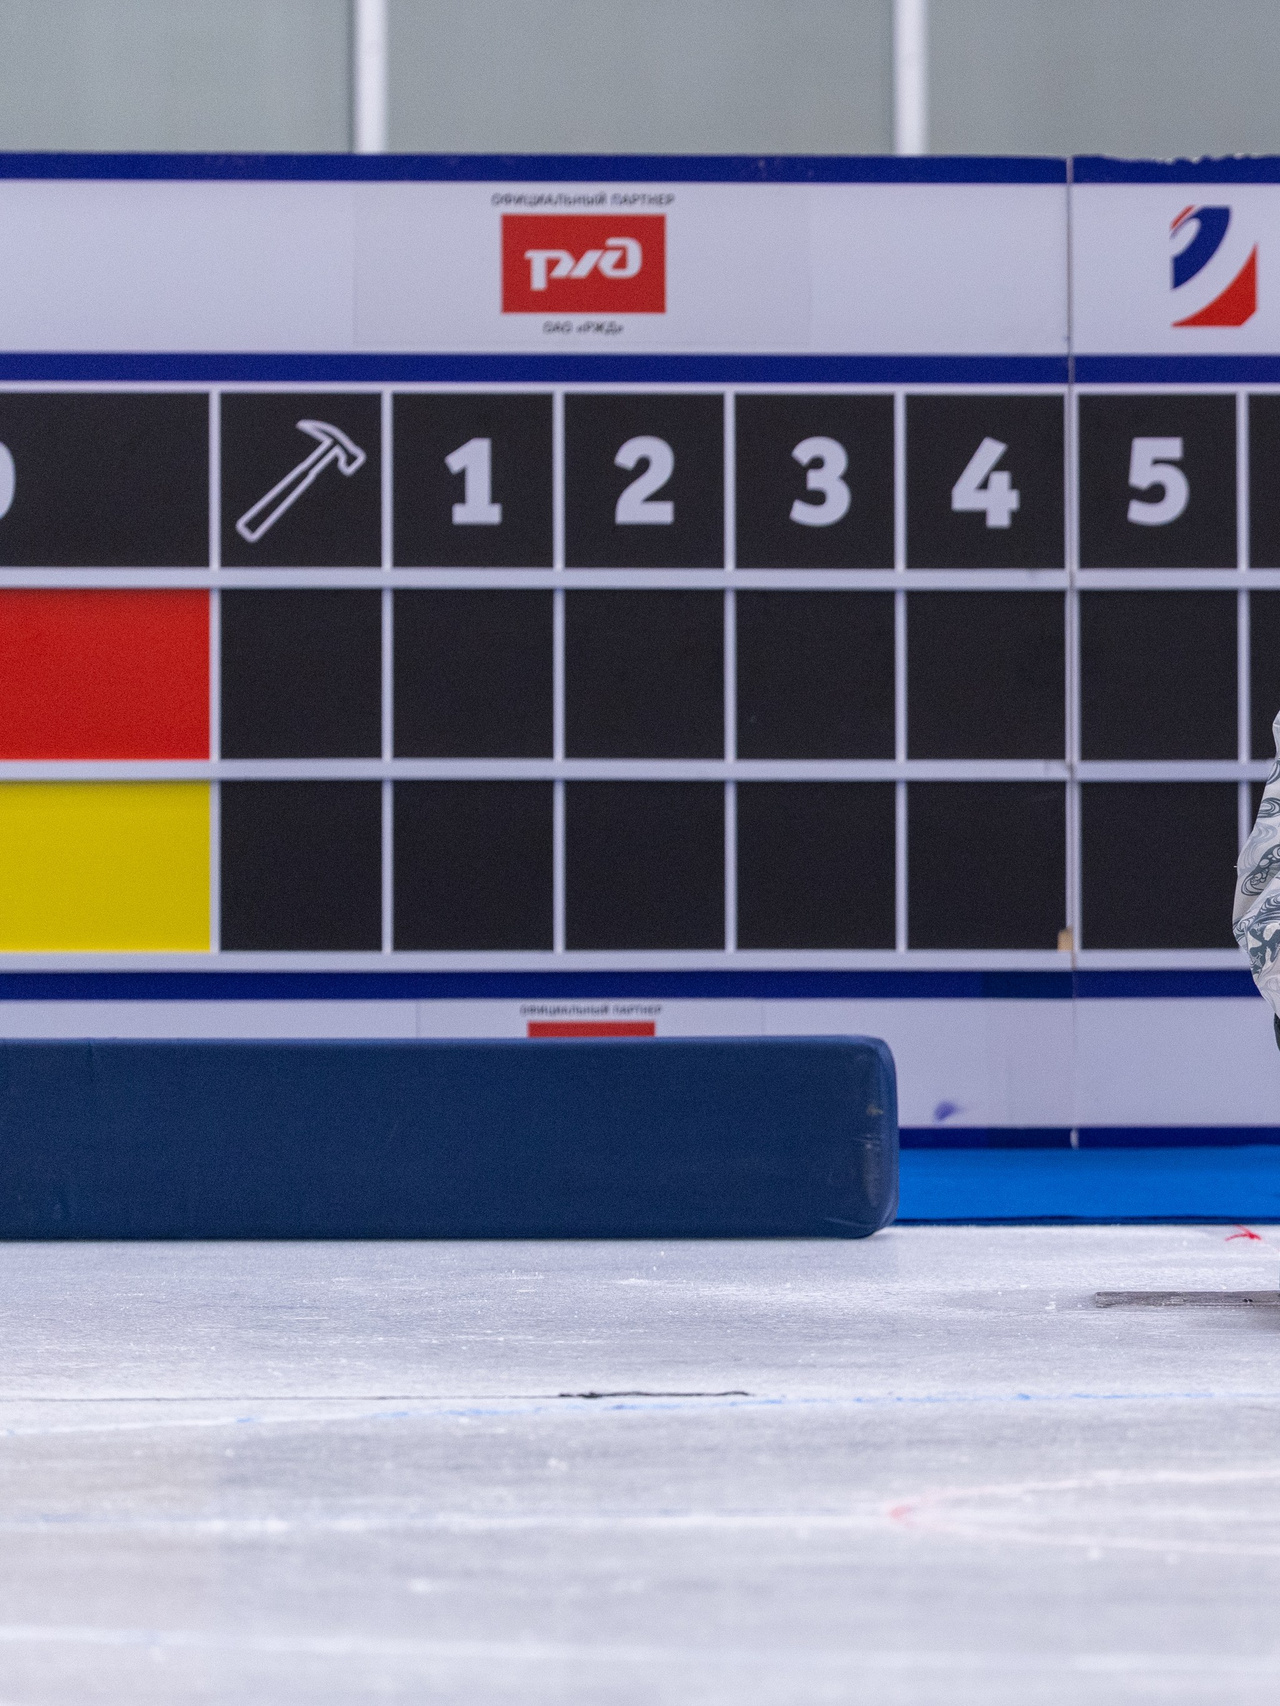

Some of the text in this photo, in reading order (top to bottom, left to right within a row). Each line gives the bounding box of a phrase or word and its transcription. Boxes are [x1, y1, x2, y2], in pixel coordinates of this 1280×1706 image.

[446, 438, 501, 525] 1
[615, 436, 674, 525] 2
[790, 436, 850, 526] 3
[952, 438, 1019, 528] 4
[1128, 437, 1189, 526] 5
